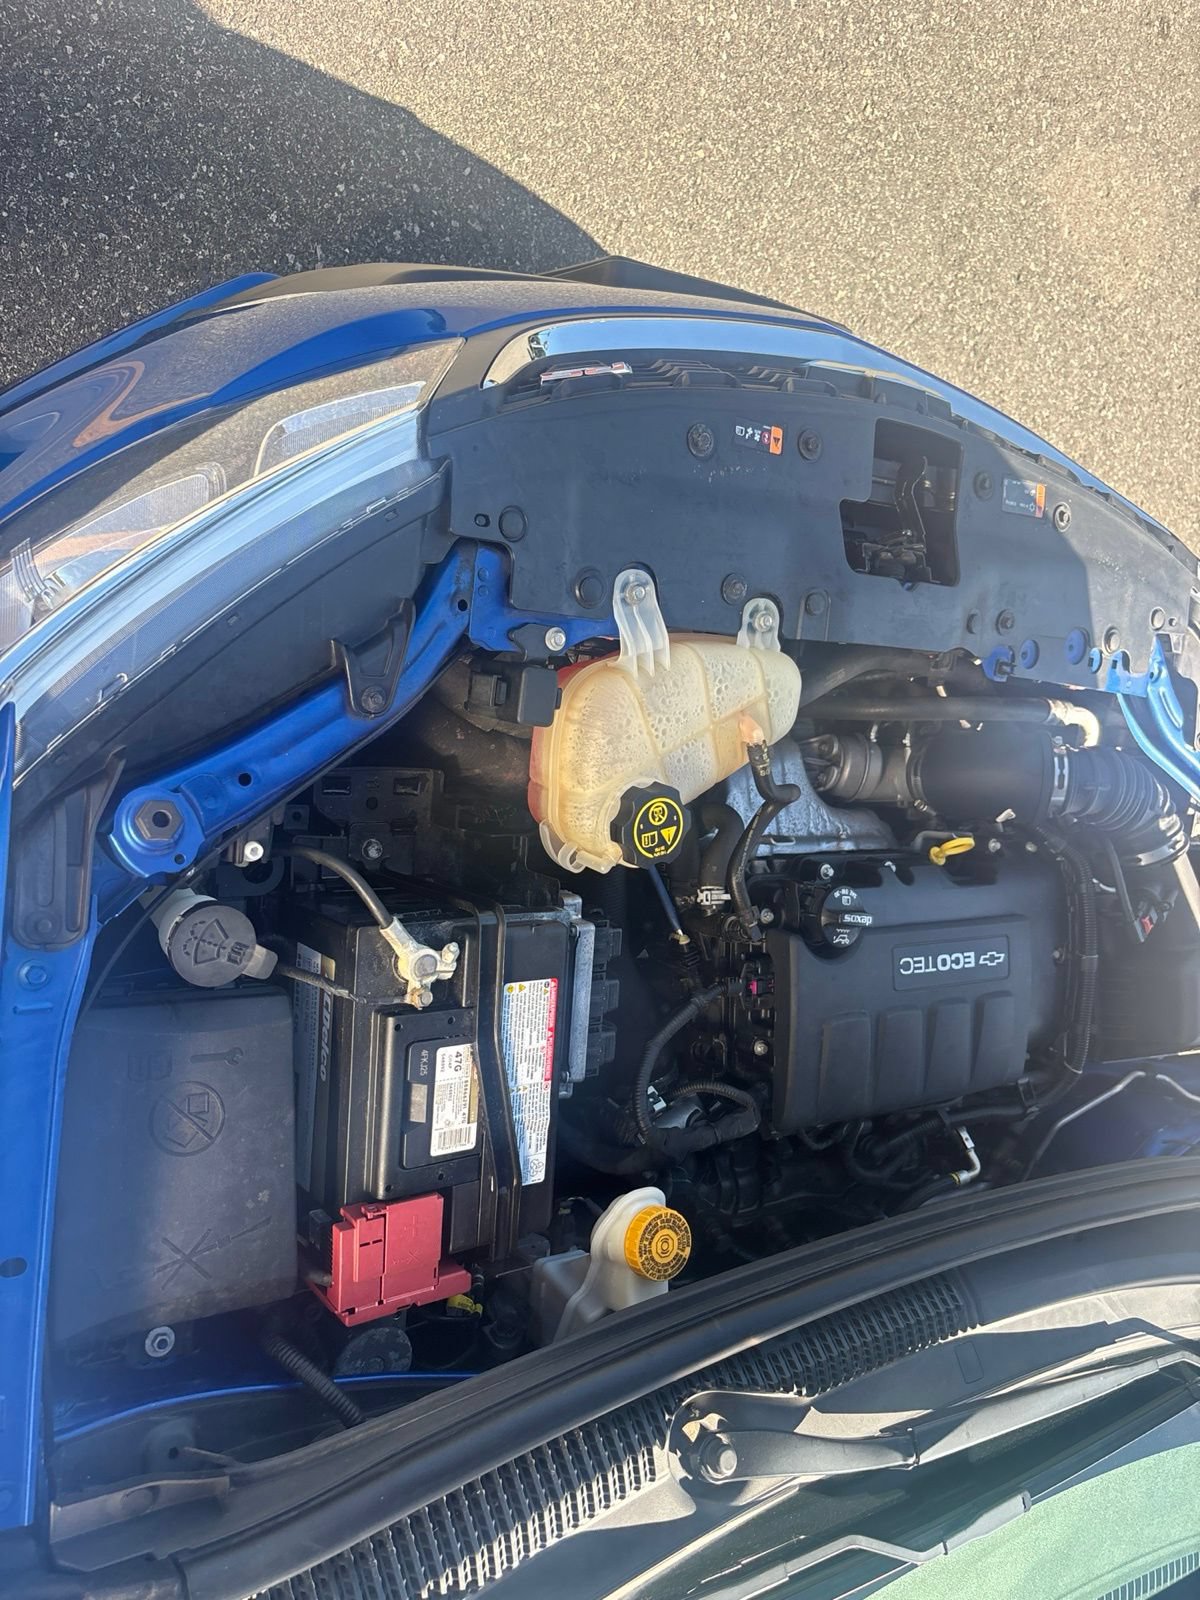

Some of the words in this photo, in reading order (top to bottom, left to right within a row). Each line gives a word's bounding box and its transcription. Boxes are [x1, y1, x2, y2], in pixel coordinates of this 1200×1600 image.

[843, 914, 873, 926] dexos
[899, 951, 975, 975] ECOTEC
[320, 976, 332, 1081] CDelco
[454, 1051, 463, 1072] 47G
